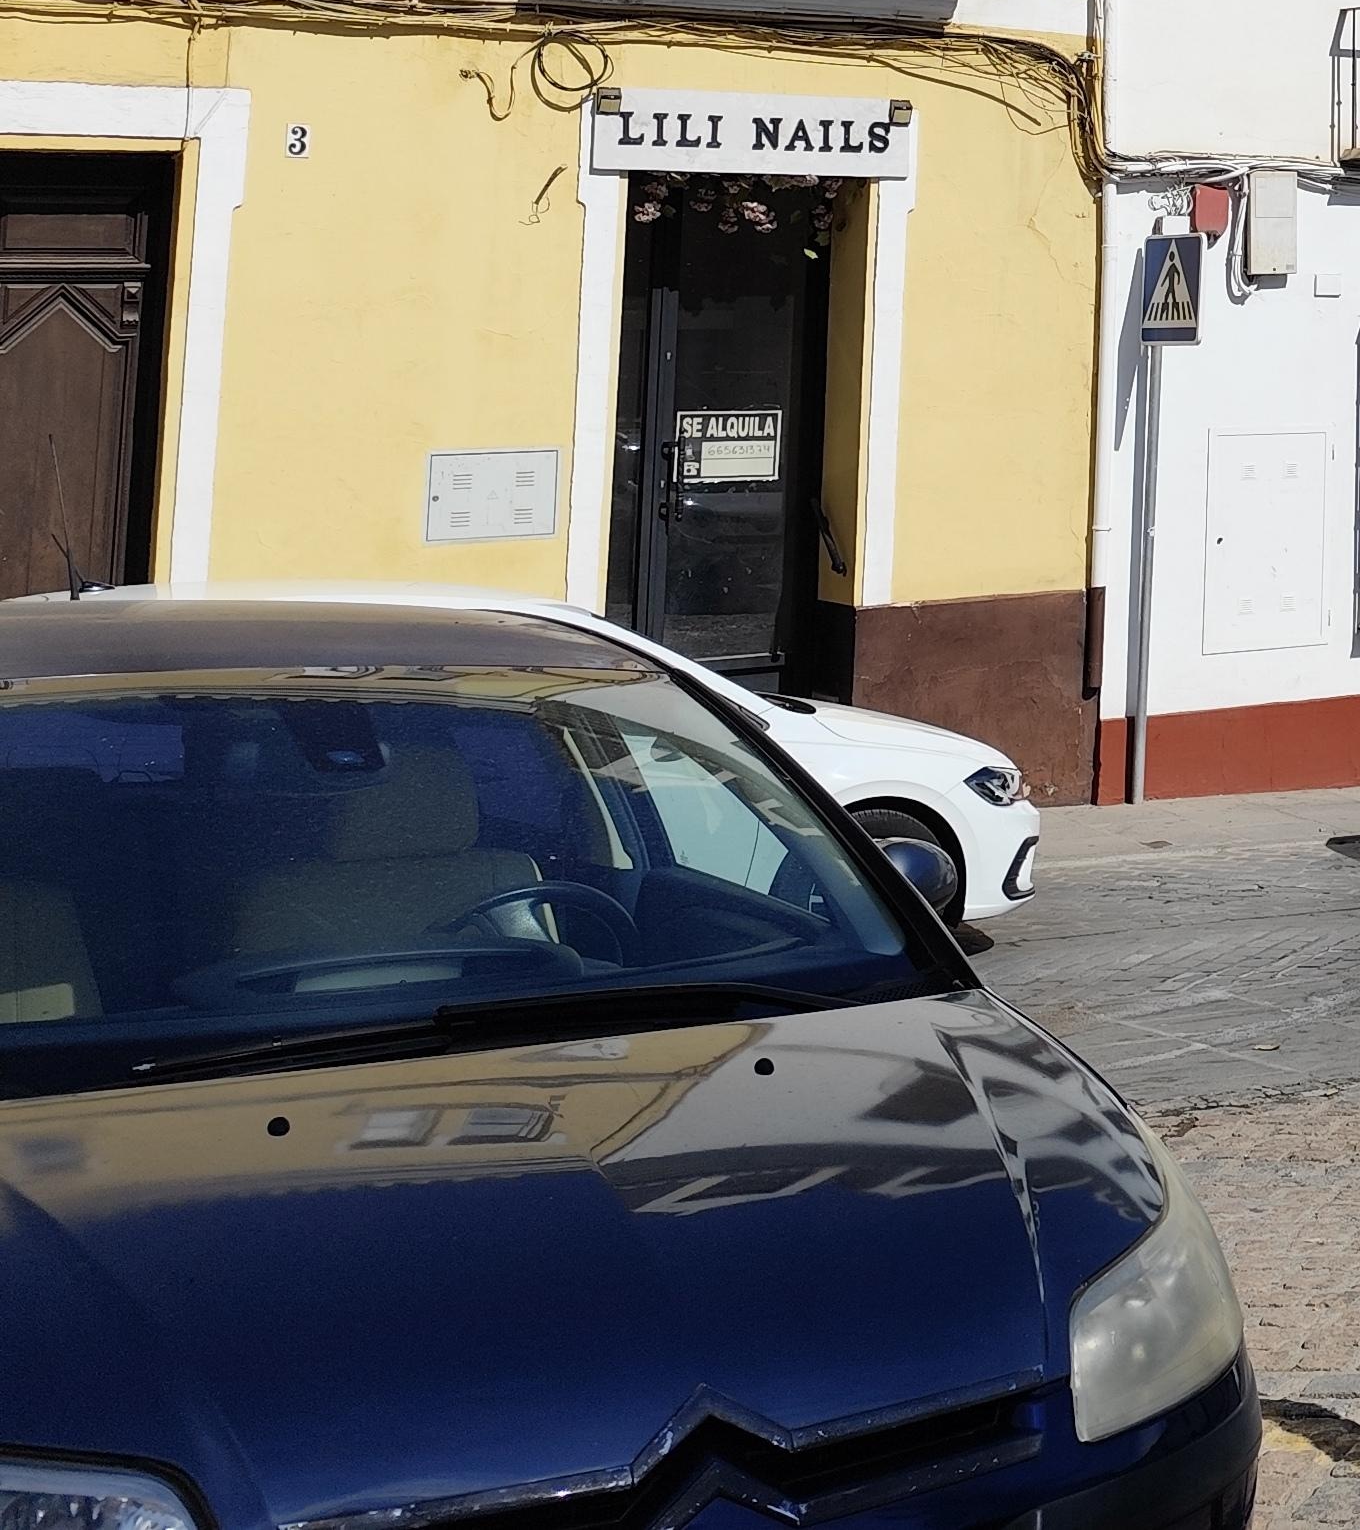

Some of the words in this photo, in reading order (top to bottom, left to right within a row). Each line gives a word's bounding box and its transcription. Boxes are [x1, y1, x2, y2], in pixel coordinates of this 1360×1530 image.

[288, 125, 308, 156] 3
[618, 111, 724, 149] LILI
[751, 117, 893, 154] NAILS
[682, 417, 703, 439] SE
[706, 416, 775, 438] ALQUILA
